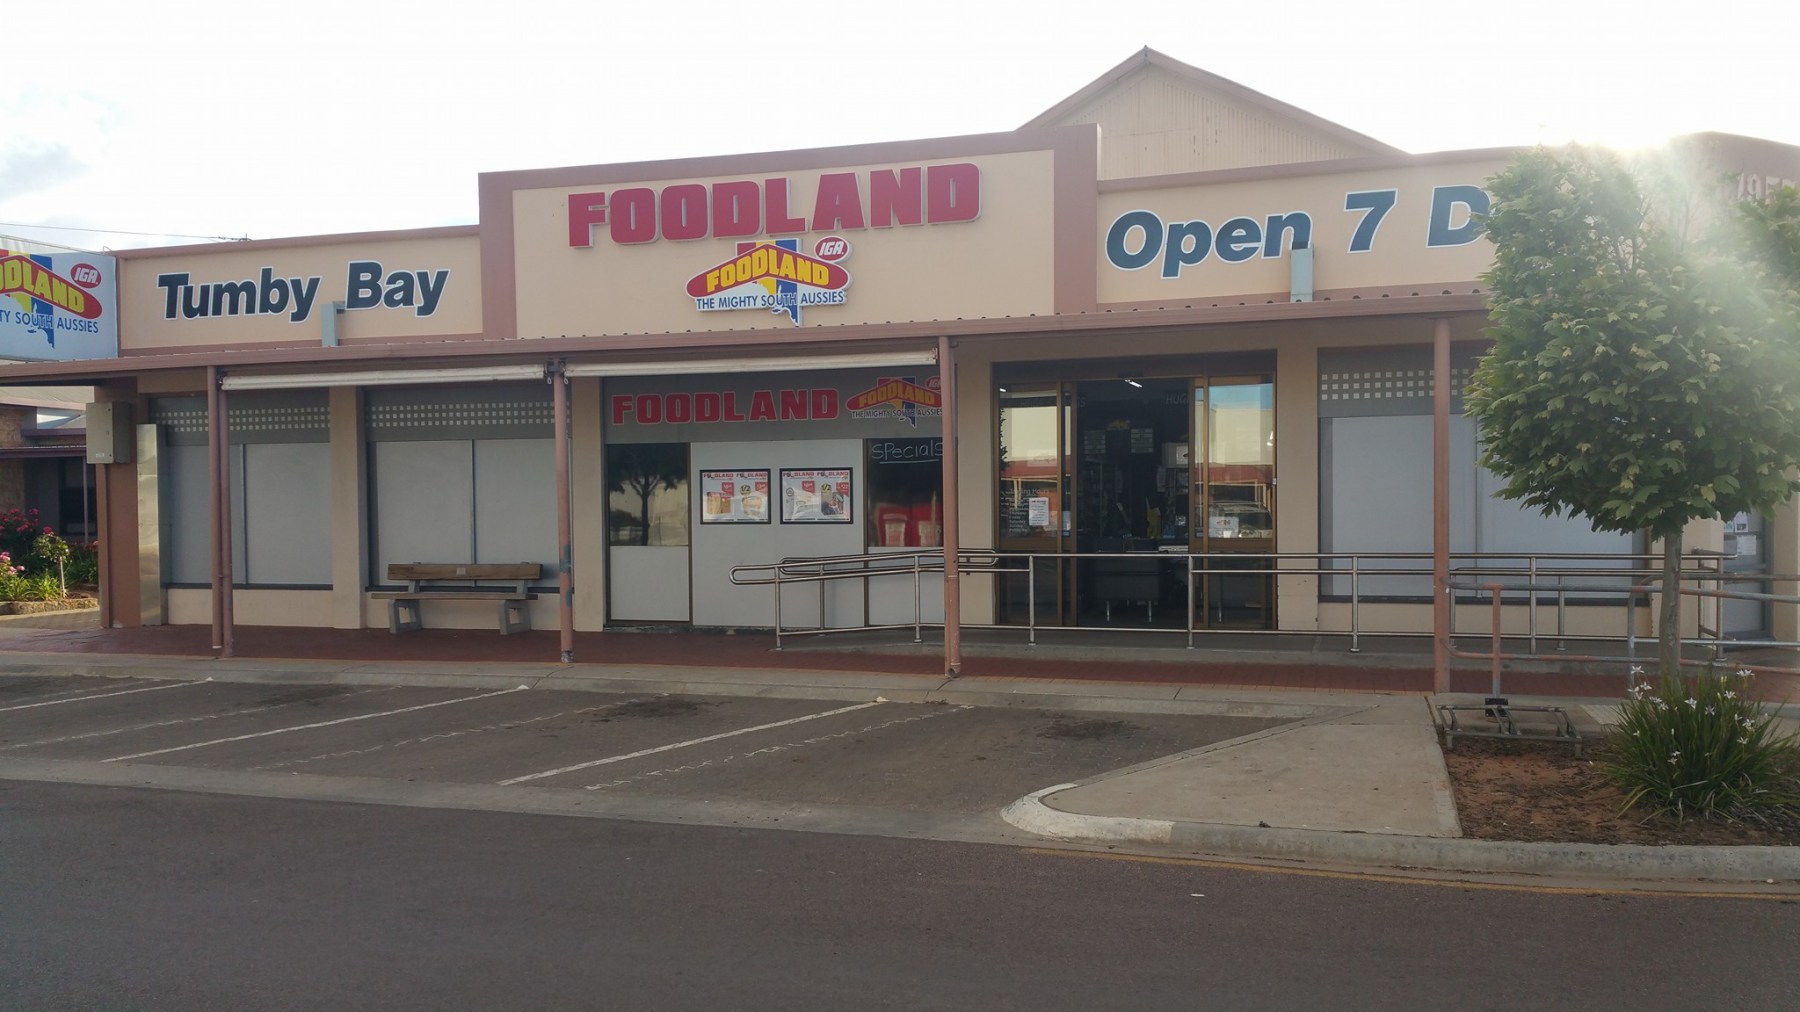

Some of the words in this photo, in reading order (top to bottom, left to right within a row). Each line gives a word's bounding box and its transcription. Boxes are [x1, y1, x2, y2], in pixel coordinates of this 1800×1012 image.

[567, 163, 982, 248] FOODLAND
[1106, 210, 1313, 279] Open
[1344, 188, 1398, 253] 7
[0, 259, 85, 313] DLAND
[157, 266, 322, 323] Tumby
[345, 260, 450, 318] Bay
[706, 248, 829, 293] FOODLAND
[697, 298, 715, 309] THE
[718, 295, 758, 308] MIGHTY
[761, 292, 798, 307] SOUTH
[801, 290, 844, 304] AUSSIES
[15, 311, 53, 329] SOUTH
[57, 317, 99, 334] AUSSIES
[612, 388, 839, 426] FOODLAND
[859, 382, 935, 408] FOODLAND
